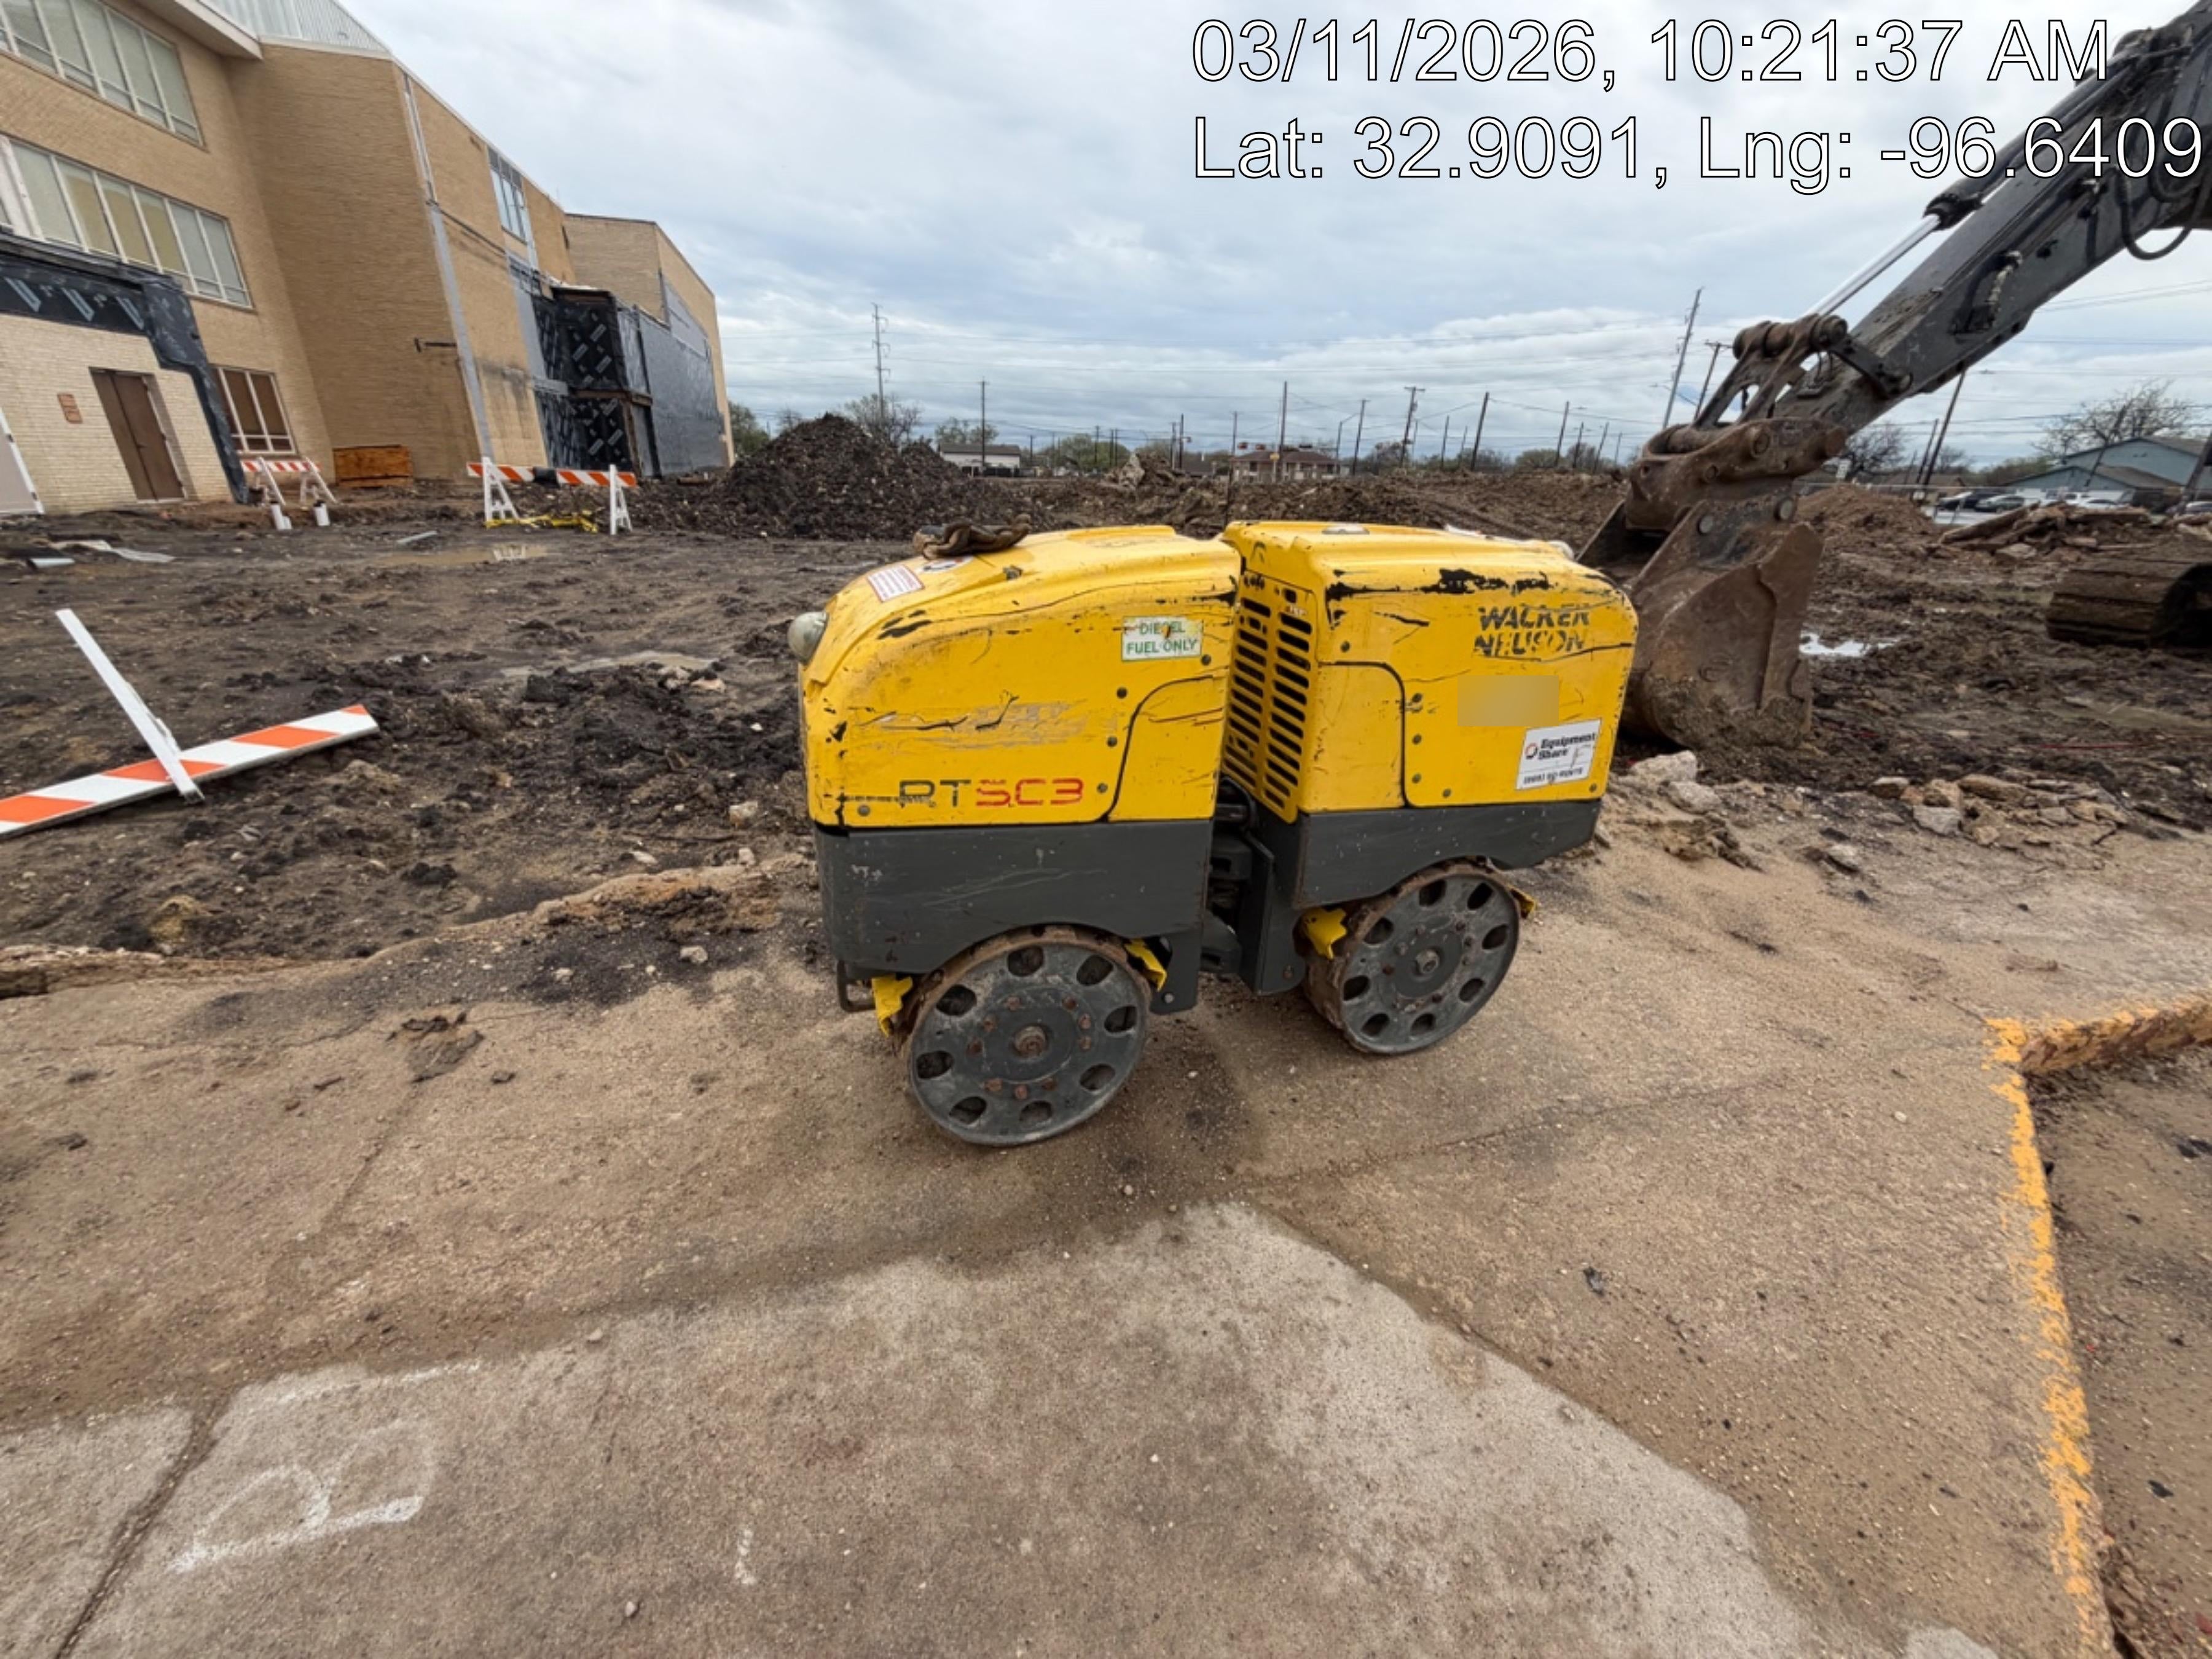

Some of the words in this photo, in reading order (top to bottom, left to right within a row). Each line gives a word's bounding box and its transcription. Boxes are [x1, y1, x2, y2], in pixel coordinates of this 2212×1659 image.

[1478, 603, 1590, 631] WACKER
[1126, 641, 1159, 654] FUEL
[1163, 638, 1198, 651] ONLY
[1540, 732, 1596, 750] Equipment
